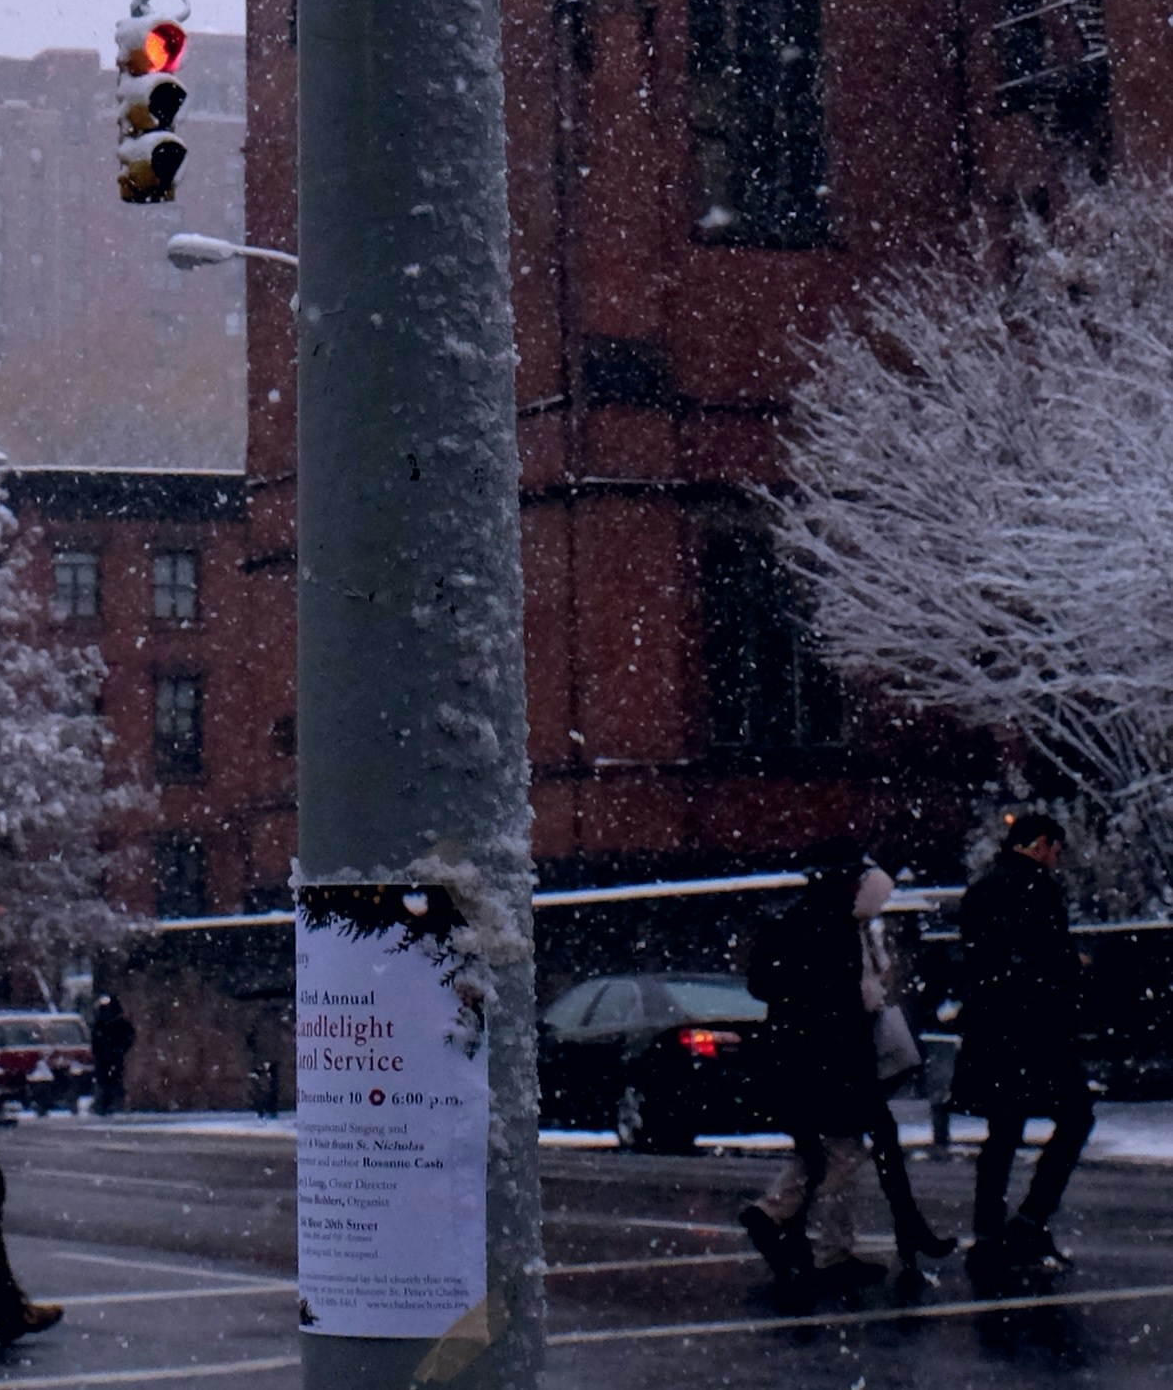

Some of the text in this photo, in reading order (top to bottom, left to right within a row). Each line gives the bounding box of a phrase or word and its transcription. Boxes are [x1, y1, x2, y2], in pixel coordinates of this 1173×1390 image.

[322, 990, 375, 1005] Annual
[298, 1015, 395, 1046] andlelight
[323, 1047, 405, 1072] Service
[349, 1091, 362, 1105] 10
[391, 1092, 423, 1106] 6:00
[429, 1094, 464, 1109] p.m.
[373, 1138, 426, 1152] Nicholas
[414, 1157, 444, 1169] Cash
[355, 1178, 398, 1190] Director
[346, 1219, 379, 1231] Street
